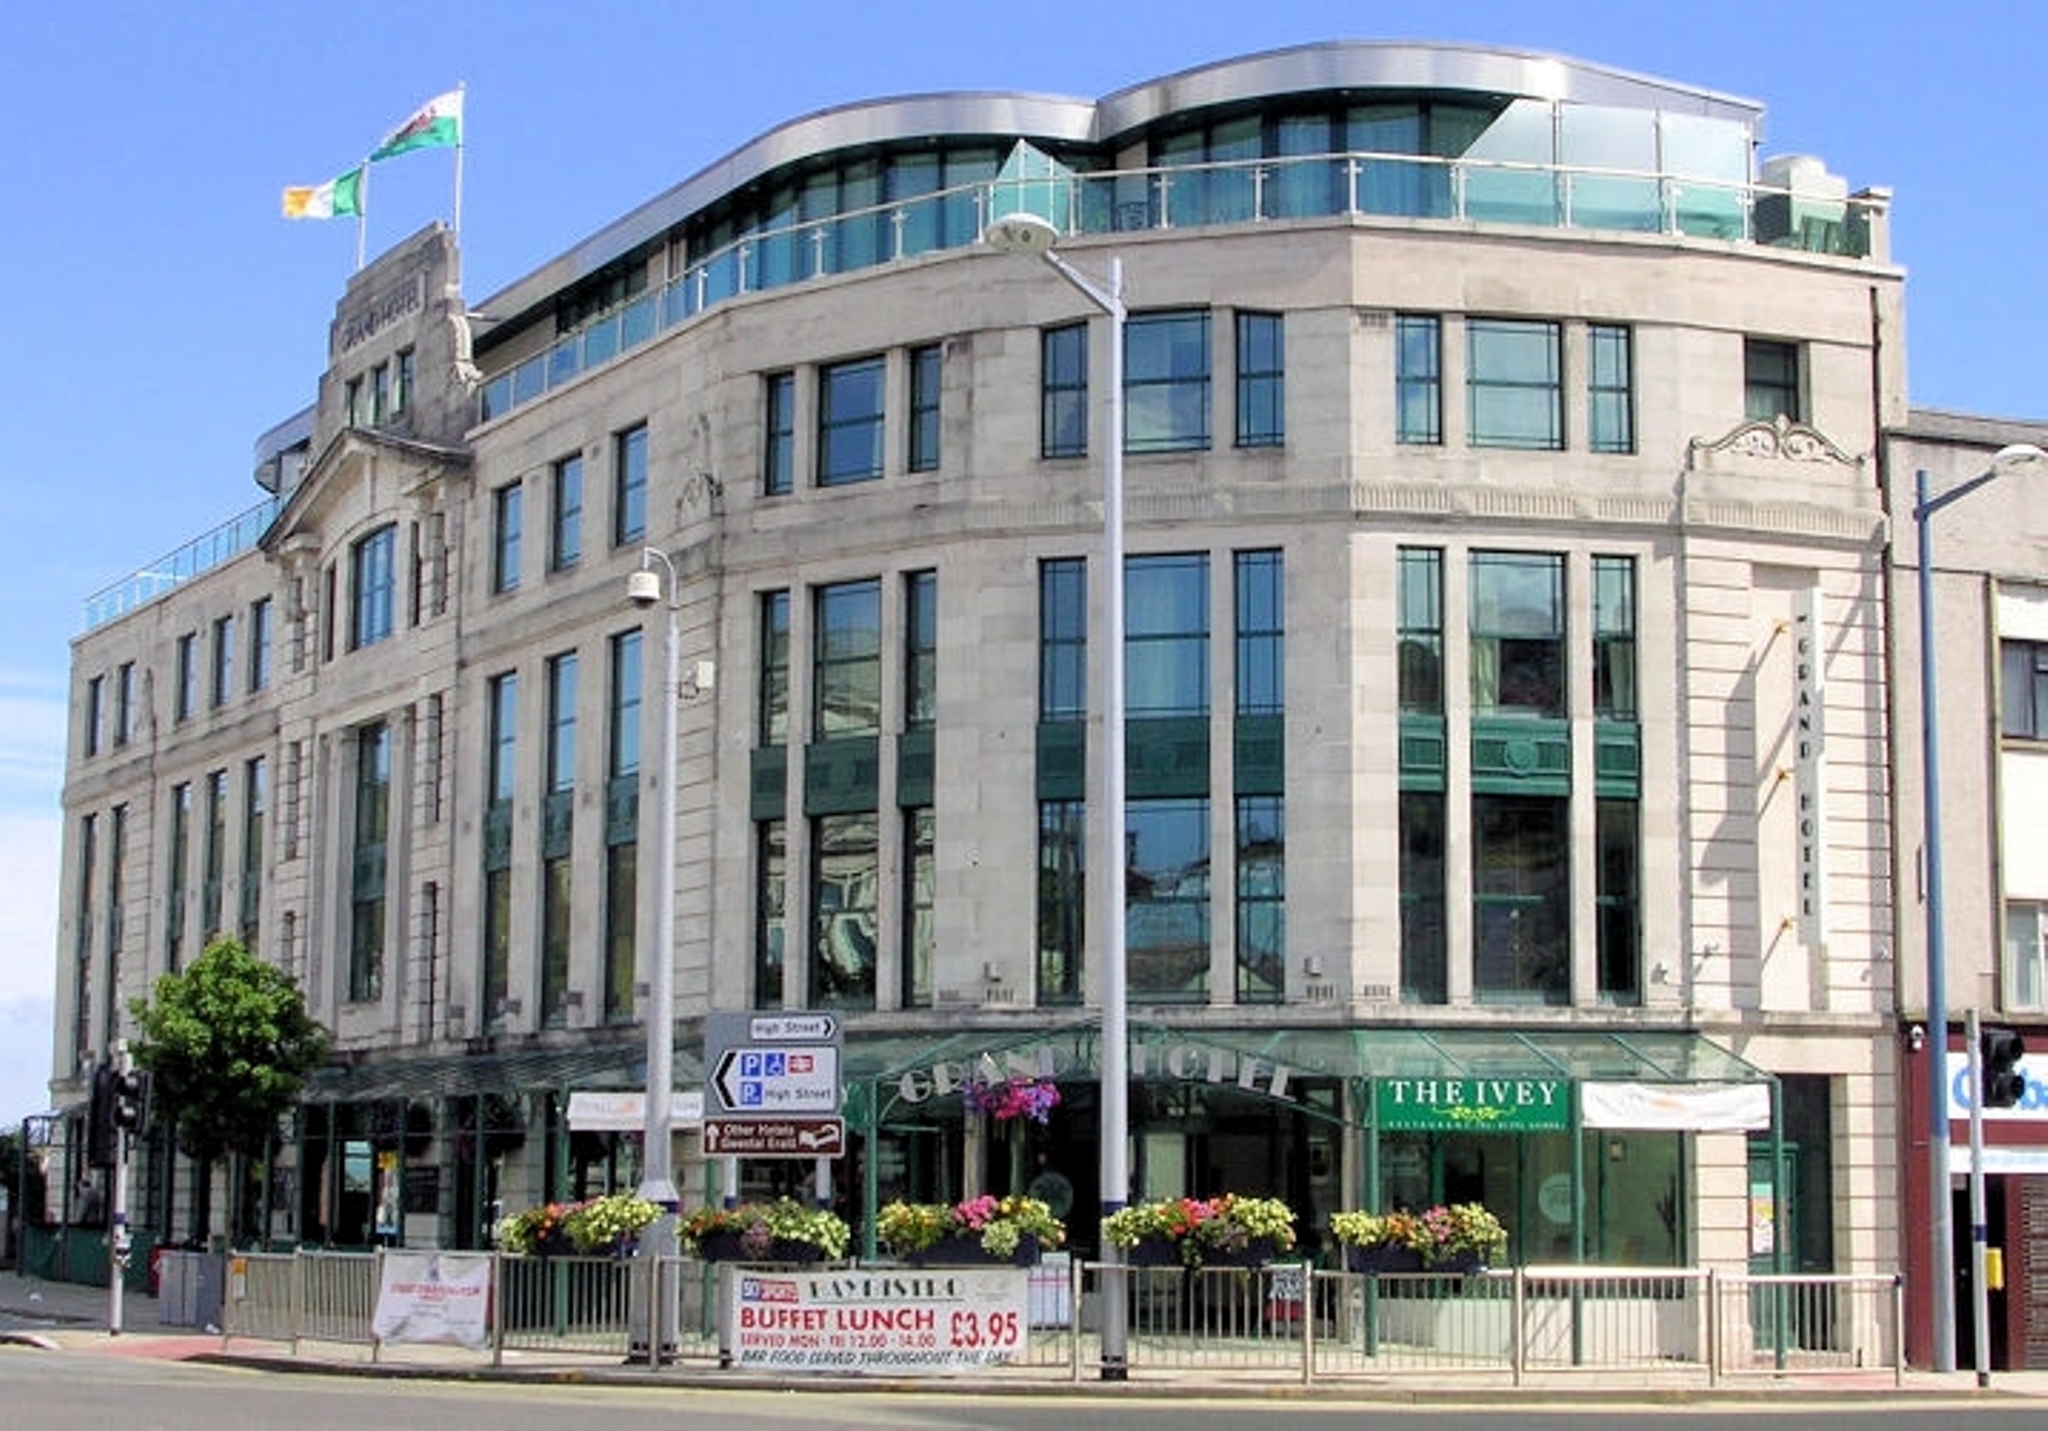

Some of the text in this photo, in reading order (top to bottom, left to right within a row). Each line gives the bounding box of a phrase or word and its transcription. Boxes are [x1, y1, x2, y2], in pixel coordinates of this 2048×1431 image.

[755, 1021, 821, 1036] High Street
[765, 1087, 791, 1101] High
[795, 1087, 832, 1099] Street
[1387, 1080, 1465, 1105] THE
[1476, 1080, 1558, 1106] IVEY
[741, 1306, 1018, 1348] BUFFET LUNCH £3.95
[740, 1333, 785, 1348] SERVED
[741, 1350, 768, 1363] BAR
[769, 1350, 807, 1364] FOOD
[809, 1350, 857, 1365] SERVED
[955, 1350, 984, 1365] THE
